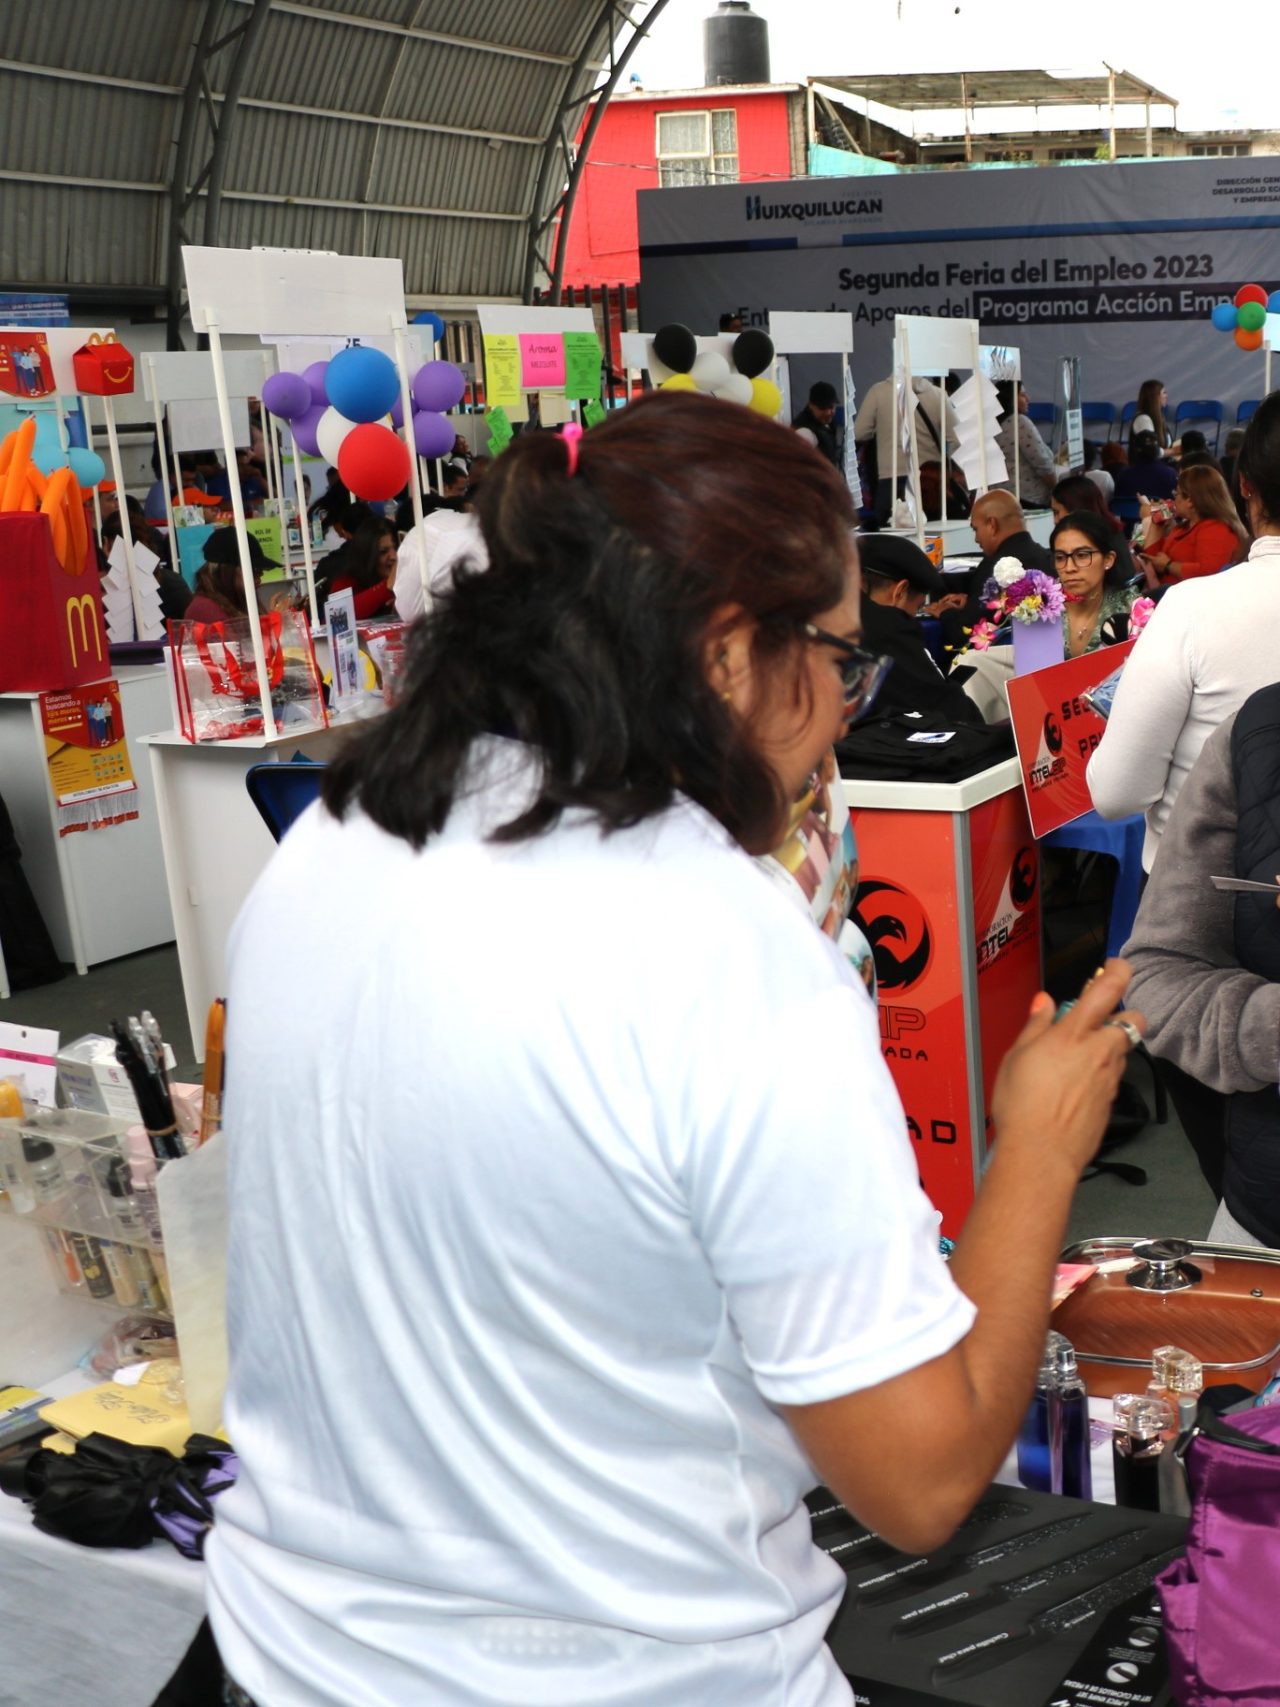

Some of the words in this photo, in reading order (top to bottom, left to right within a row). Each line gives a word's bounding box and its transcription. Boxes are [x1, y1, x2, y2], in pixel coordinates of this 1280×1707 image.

[1217, 176, 1261, 186] DIRECCIÓN
[1212, 186, 1267, 195] DESARROLLO
[745, 195, 883, 221] HUIXQUILUCAN
[838, 263, 940, 295] Segunda
[945, 261, 1006, 287] Feria
[1010, 258, 1048, 284] del
[1054, 256, 1148, 286] Empleo
[1152, 254, 1214, 280] 2023
[937, 297, 970, 318] del
[979, 291, 1089, 323] Programa
[1095, 288, 1175, 316] Acción
[896, 1558, 928, 1573] Cuchillo
[936, 1591, 969, 1607] Cuchillo
[901, 1610, 918, 1620] pan
[917, 1603, 937, 1615] para
[975, 1632, 1009, 1648] Cuchillo
[956, 1644, 976, 1656] para
[938, 1652, 957, 1664] chef
